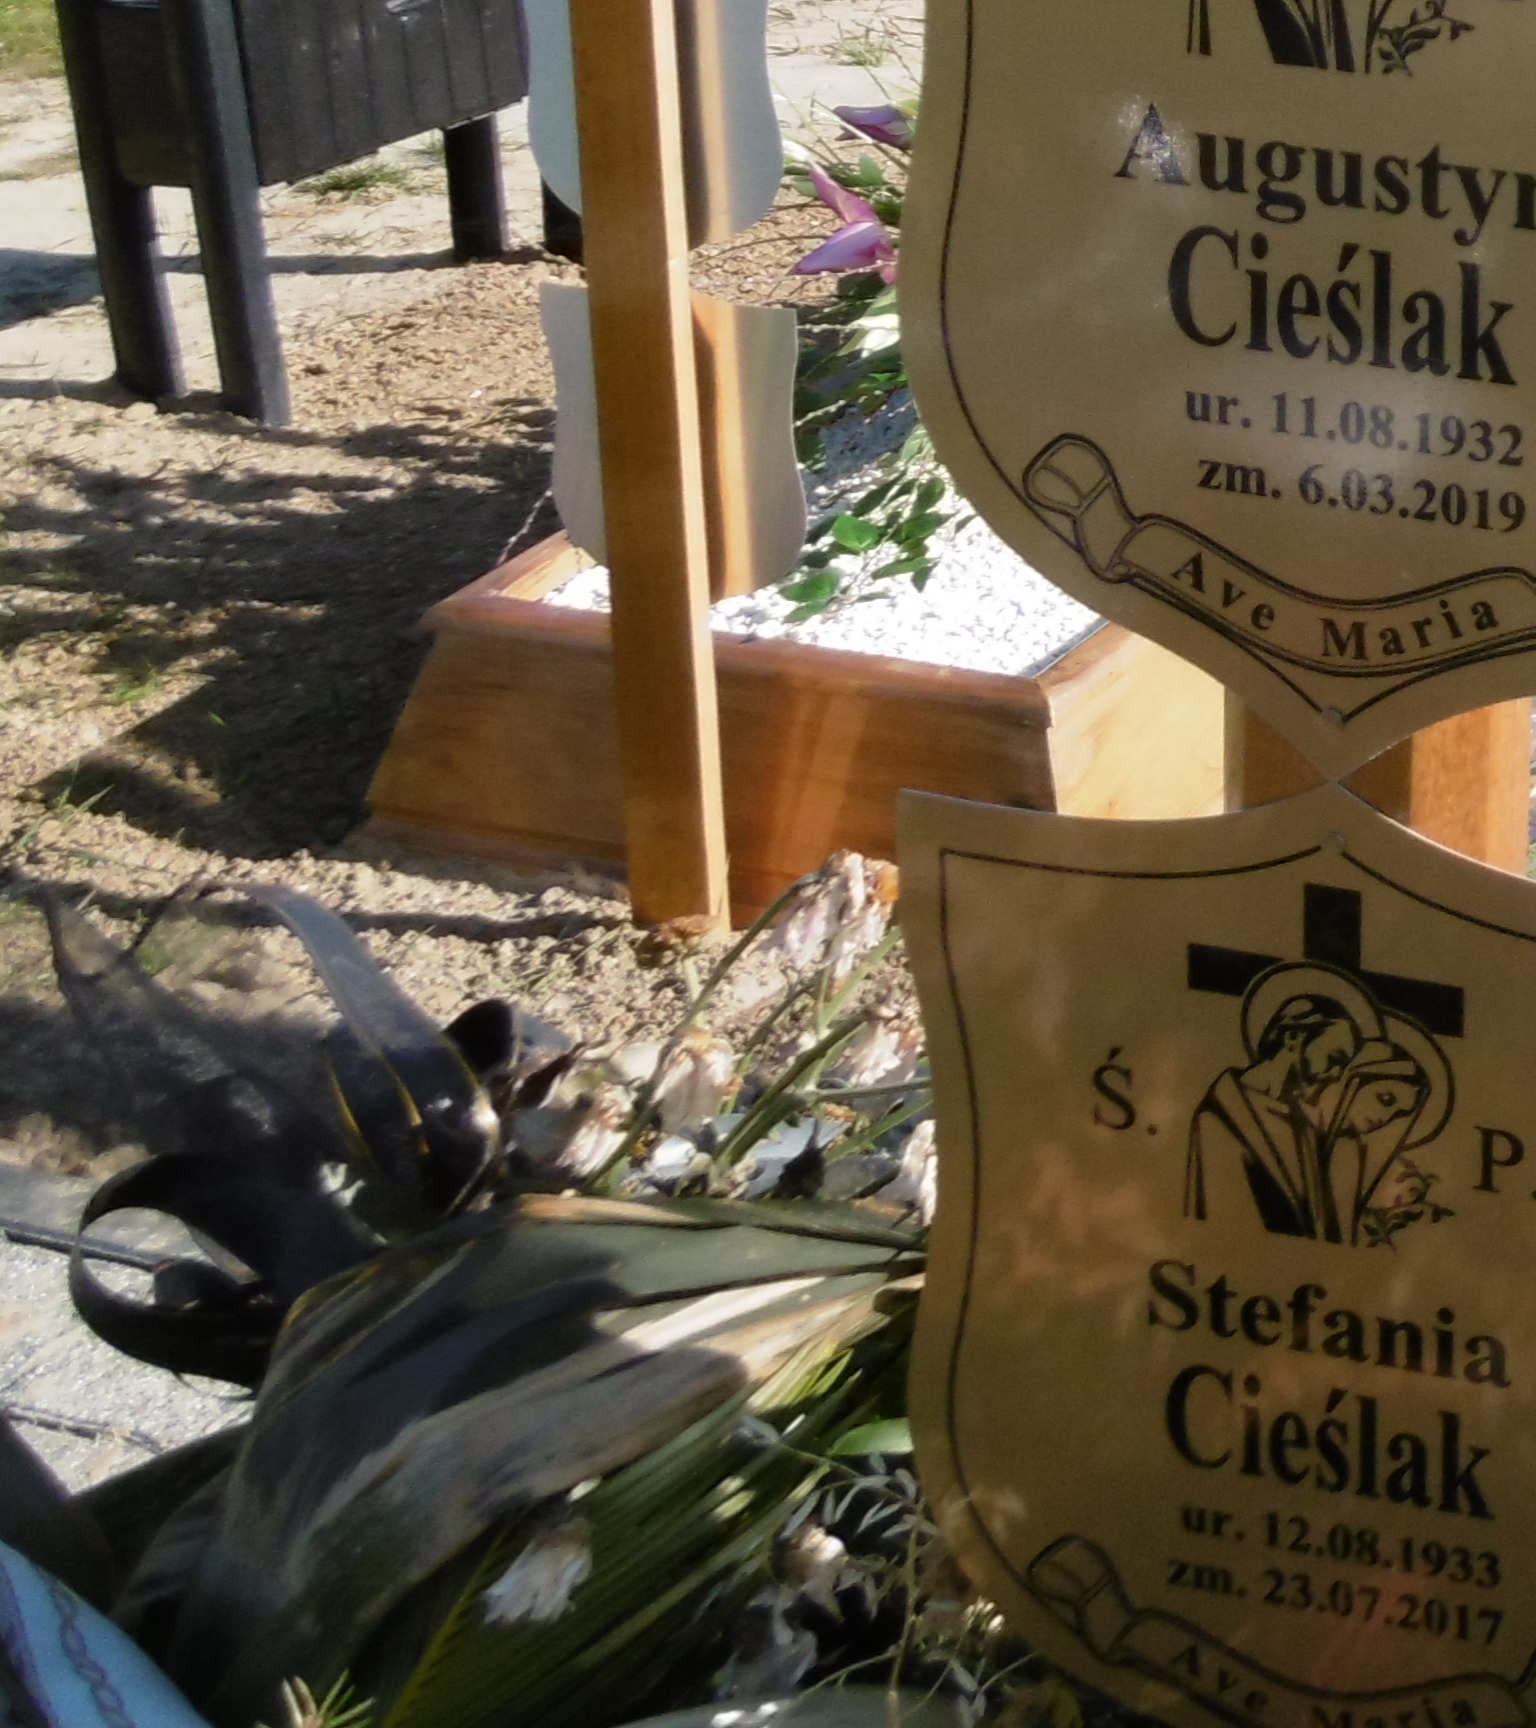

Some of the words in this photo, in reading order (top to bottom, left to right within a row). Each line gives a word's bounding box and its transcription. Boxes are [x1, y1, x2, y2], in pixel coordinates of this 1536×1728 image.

[1167, 224, 1518, 387] Cieślak
[1185, 389, 1251, 430] ur.
[1271, 391, 1524, 468] 11.08.1932
[1196, 459, 1282, 501] zm.
[1297, 464, 1527, 533] 6.03.2019
[1169, 551, 1275, 632] Ave
[1318, 599, 1501, 662] Maria
[1091, 1045, 1158, 1137] Ś.
[1144, 1259, 1512, 1389] Stefania
[1163, 1362, 1496, 1522] Cieślak
[1180, 1505, 1246, 1543] ur.
[1262, 1510, 1502, 1591] 12.08.1933
[1166, 1558, 1249, 1601] zm.
[1261, 1566, 1505, 1648] 23.07.2017
[1168, 1643, 1270, 1713] Ave
